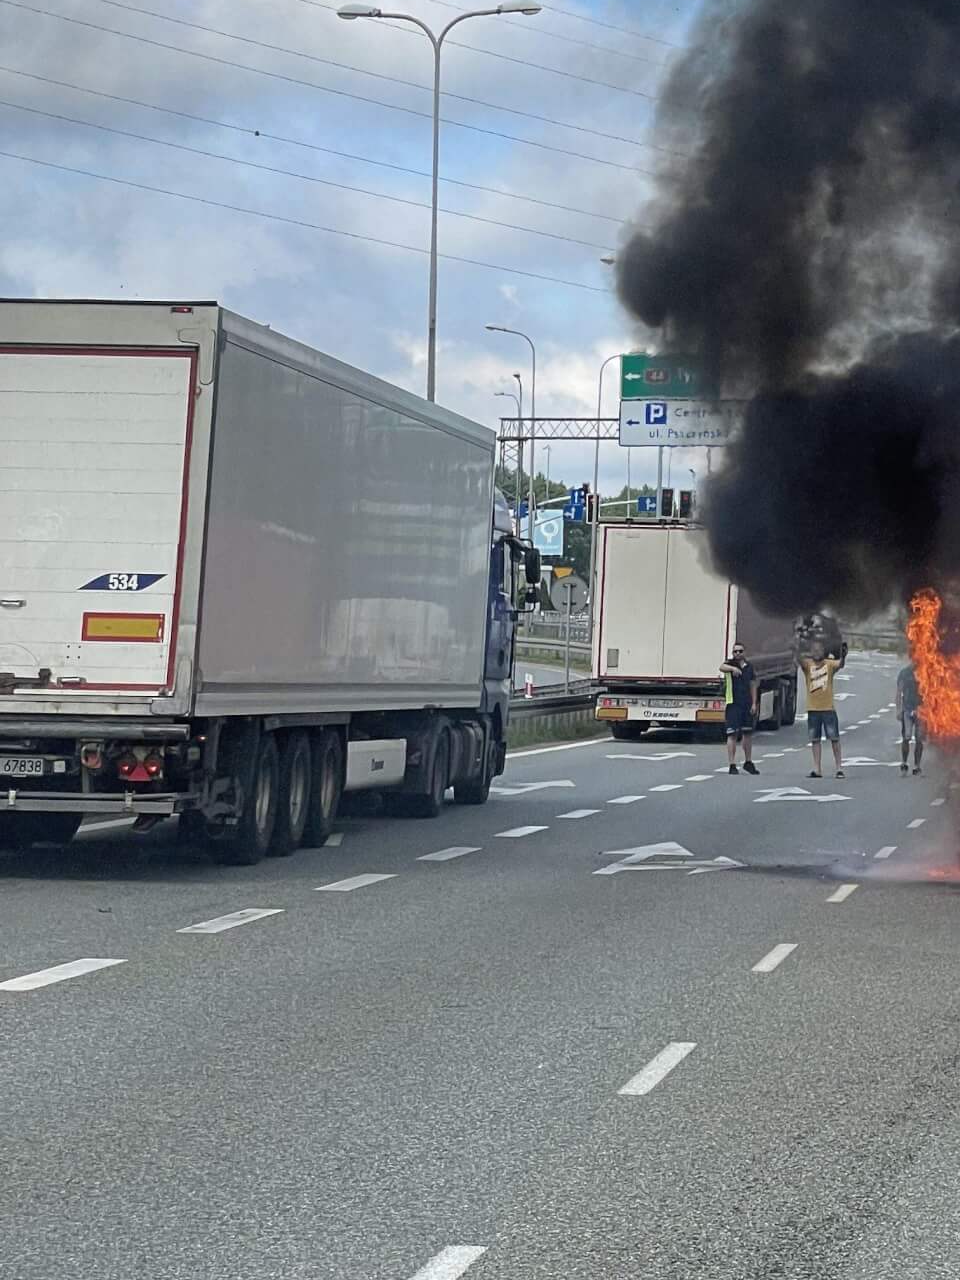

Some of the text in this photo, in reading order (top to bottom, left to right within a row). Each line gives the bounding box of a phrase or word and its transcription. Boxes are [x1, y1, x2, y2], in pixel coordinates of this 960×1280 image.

[649, 428, 662, 439] ul.
[108, 574, 139, 590] 534
[4, 759, 42, 773] 67838
